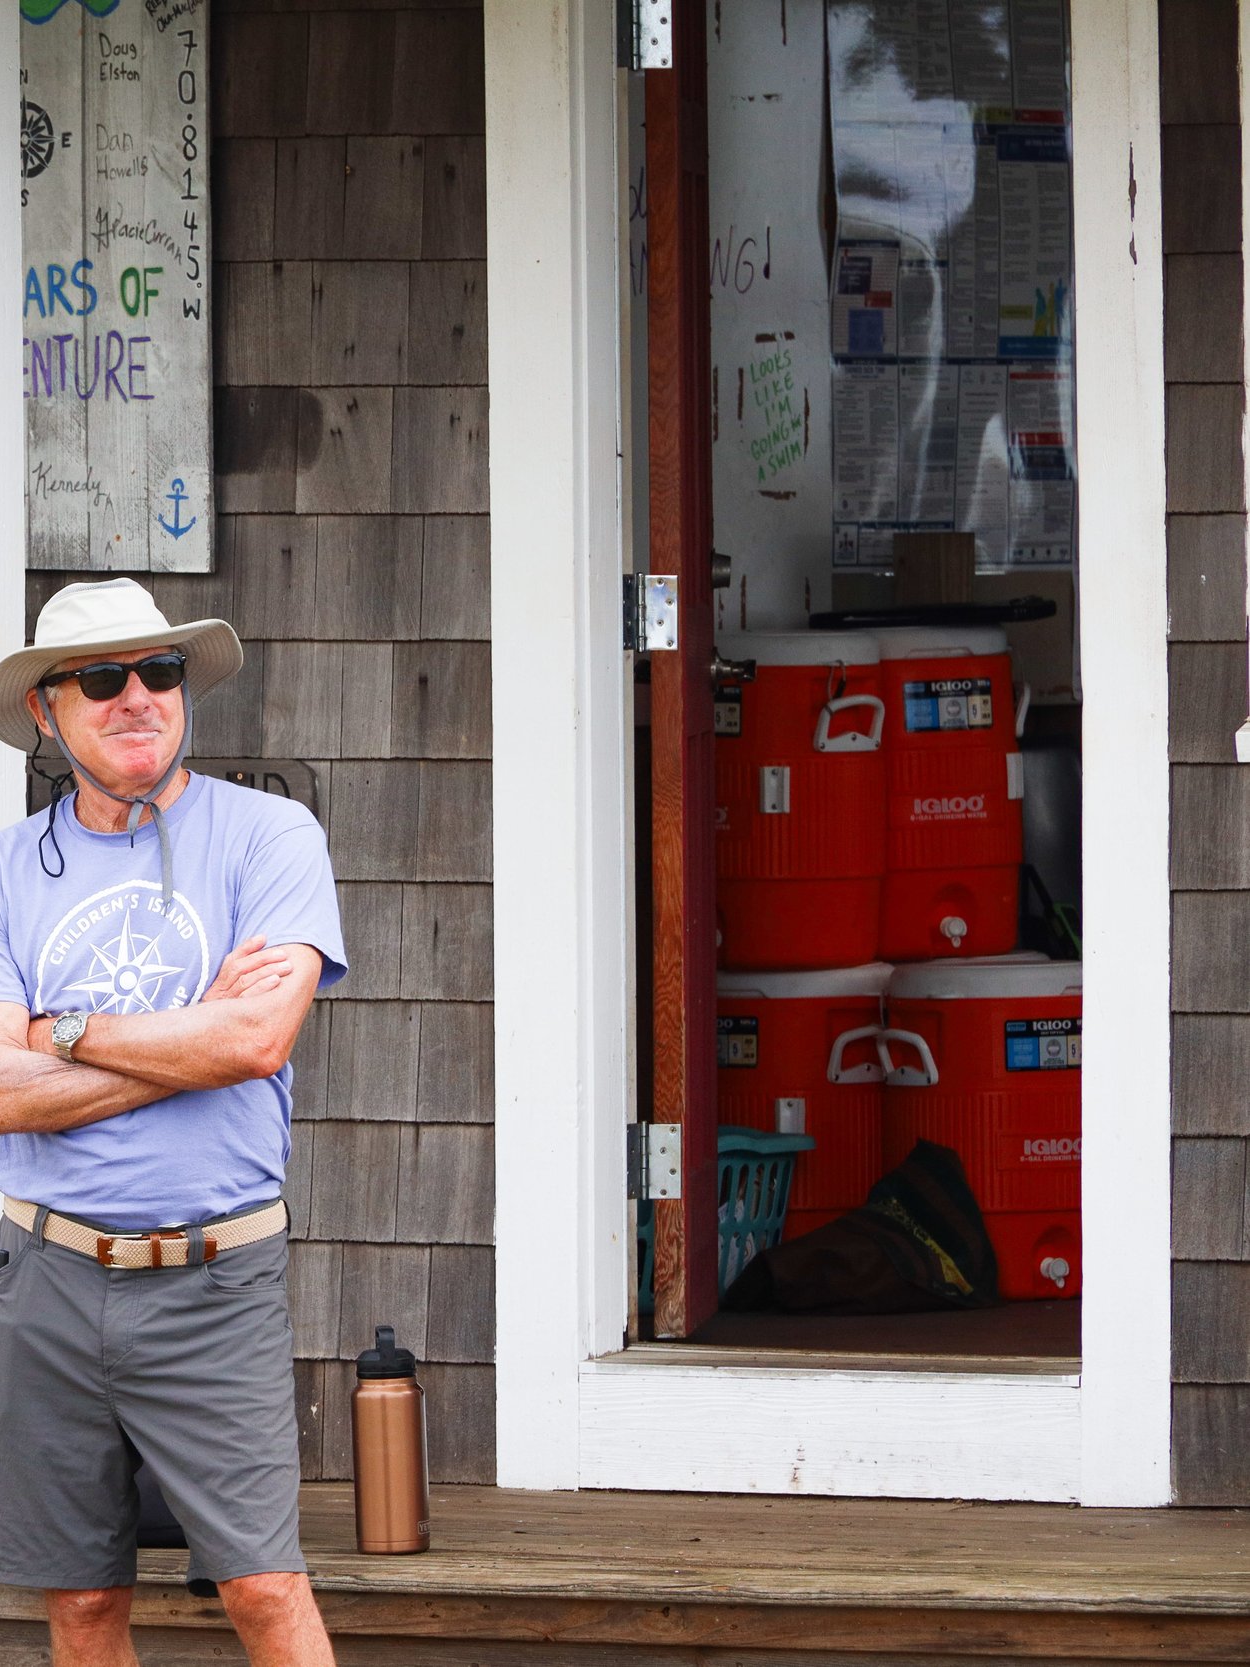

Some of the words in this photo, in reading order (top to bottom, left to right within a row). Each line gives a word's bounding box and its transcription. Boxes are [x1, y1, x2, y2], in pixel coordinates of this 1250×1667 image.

[98, 32, 137, 59] Doug
[99, 62, 140, 82] Elston
[61, 132, 73, 148] E
[96, 124, 134, 152] Dan
[120, 266, 164, 317] OF
[750, 349, 792, 384] LOOKS
[754, 371, 794, 407] LIKE
[764, 396, 792, 426] I'M
[750, 421, 790, 461] GOING
[758, 464, 767, 484] A
[768, 440, 802, 477] SWIM
[931, 680, 972, 693] IGLOO
[913, 796, 984, 814] IGLOO
[49, 893, 140, 966] CHILDREN'S
[1032, 1020, 1071, 1031] IGLOO
